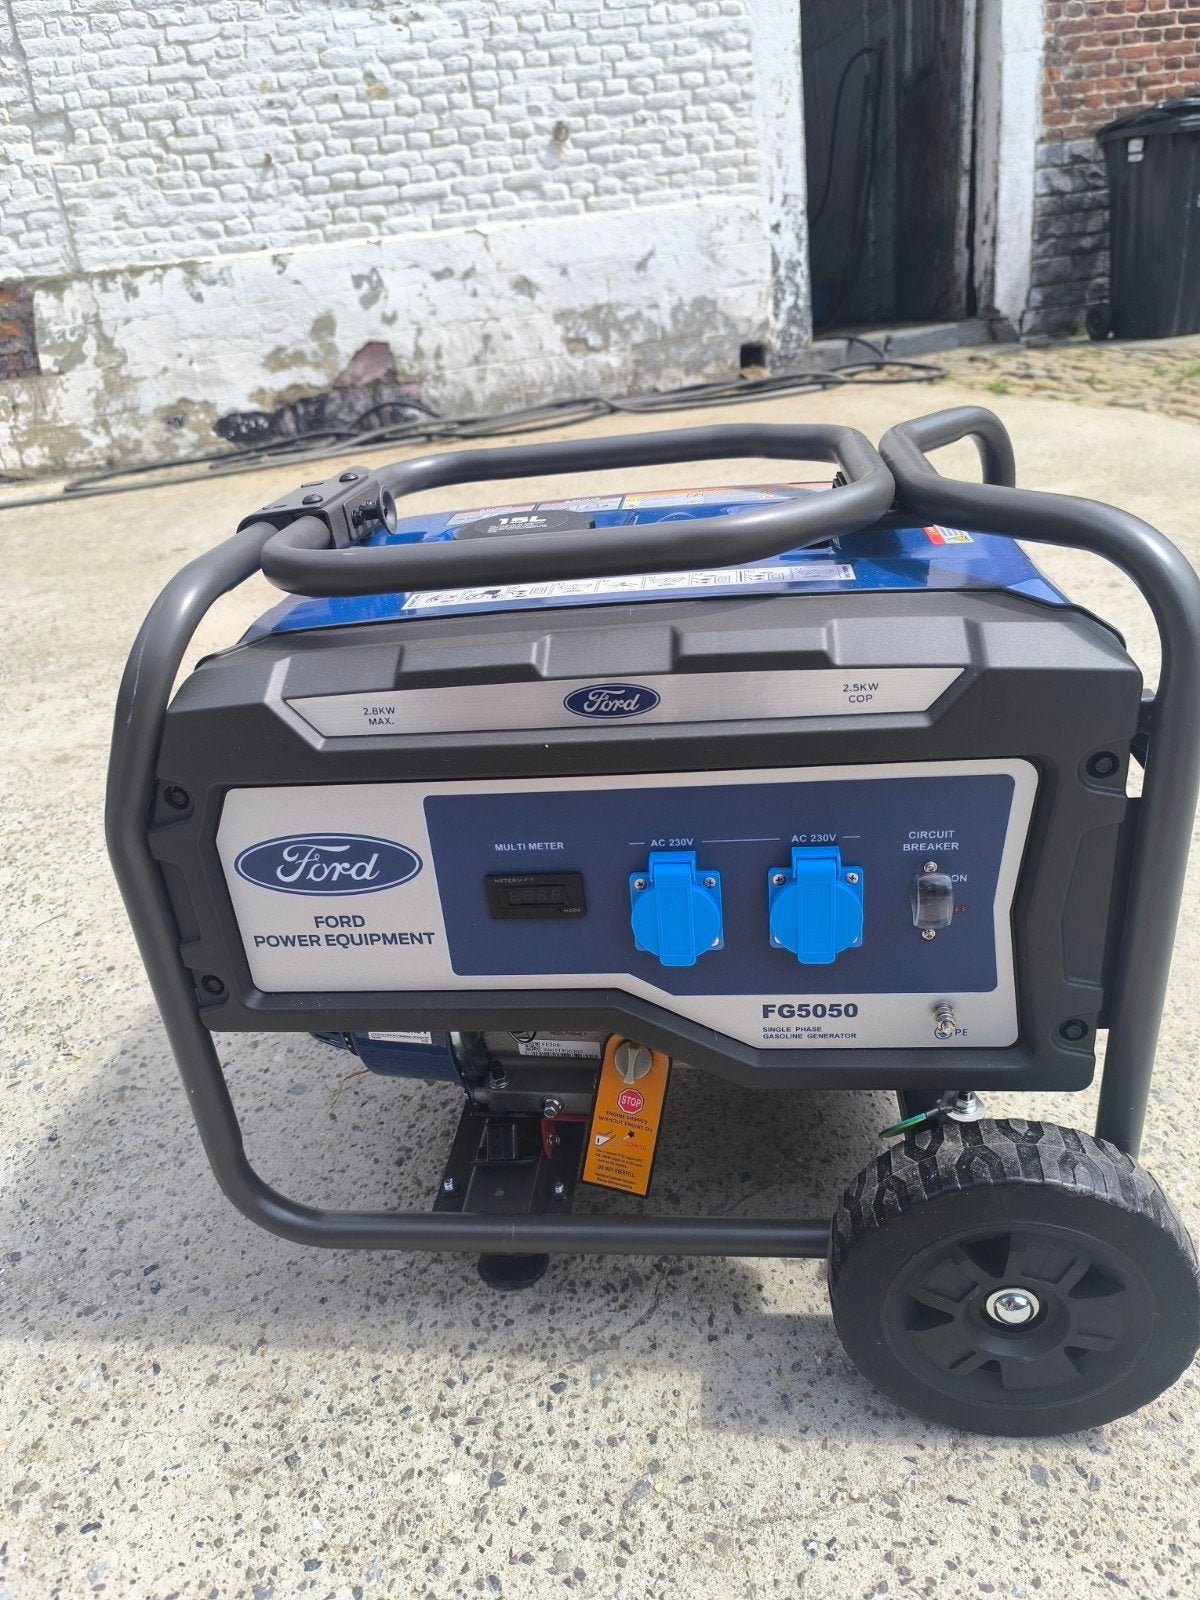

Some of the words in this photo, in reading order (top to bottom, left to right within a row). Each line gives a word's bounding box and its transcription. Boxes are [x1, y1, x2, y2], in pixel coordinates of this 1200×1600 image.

[499, 516, 546, 525] 15L
[842, 682, 879, 692] 2.5KW
[583, 690, 640, 712] Ford
[848, 694, 873, 703] COP
[363, 707, 395, 715] 2.8KW
[368, 718, 394, 726] MAX.
[791, 835, 808, 843] AC
[810, 834, 837, 842] 230V
[908, 830, 956, 839] CIRCUIT
[494, 843, 526, 851] MULTI
[528, 842, 565, 850] METER
[668, 838, 694, 846] 230V
[903, 842, 959, 851] BREAKER
[276, 844, 380, 883] Ford
[951, 874, 968, 882] ON
[314, 915, 366, 928] FORD
[253, 934, 322, 948] POWER
[325, 932, 435, 949] EQUIPMENT
[762, 1003, 859, 1018] FG5050
[955, 1028, 968, 1036] PE
[621, 1095, 642, 1108] STOP
[606, 1110, 625, 1119] ENGINE
[598, 1115, 624, 1126] WITHOUT
